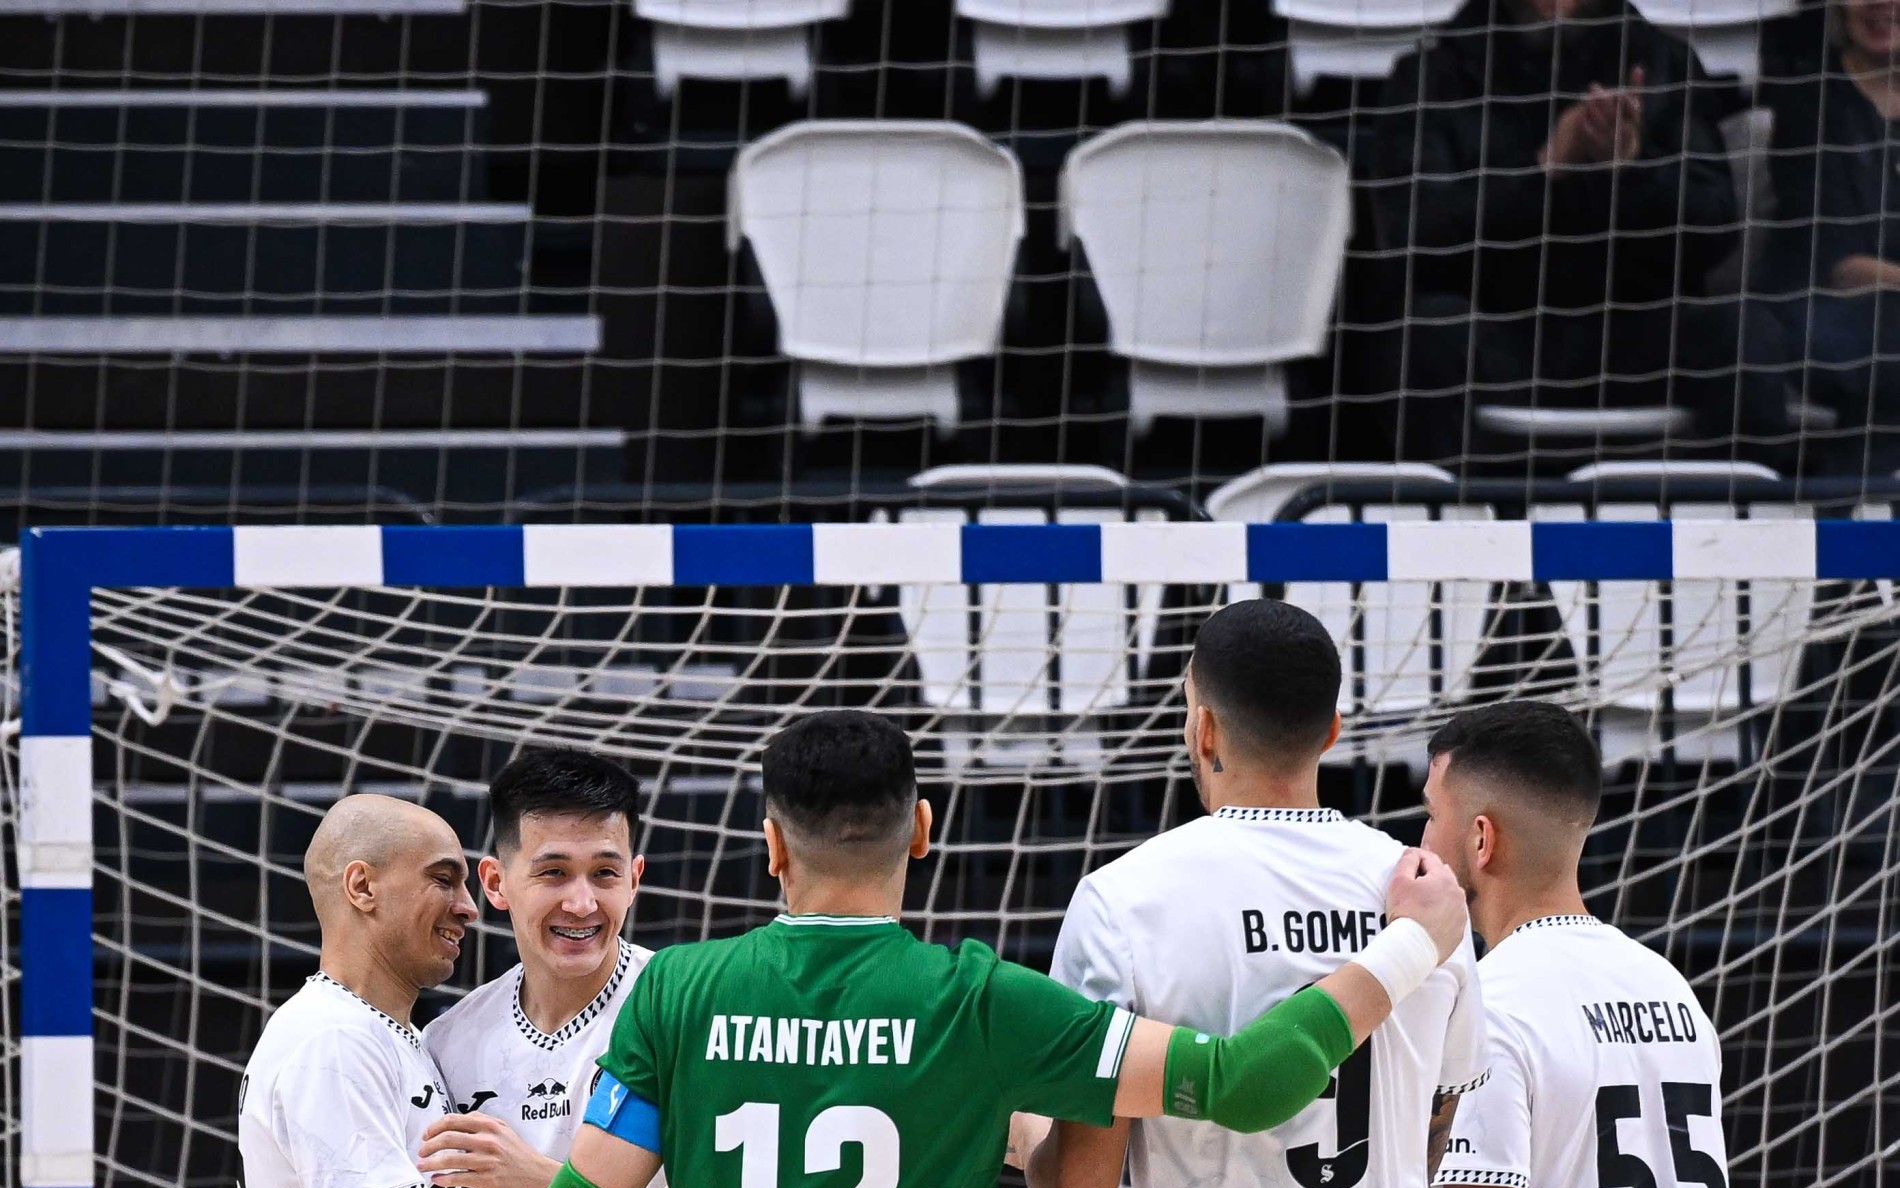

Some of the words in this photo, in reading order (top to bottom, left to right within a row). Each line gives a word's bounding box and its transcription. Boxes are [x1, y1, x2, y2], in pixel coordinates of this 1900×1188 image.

[1241, 908, 1387, 954] B.GOME
[705, 1014, 917, 1067] ATANTAYEV
[1581, 1001, 1698, 1044] MARCELO
[521, 1104, 549, 1121] Red
[549, 1099, 571, 1118] Bull
